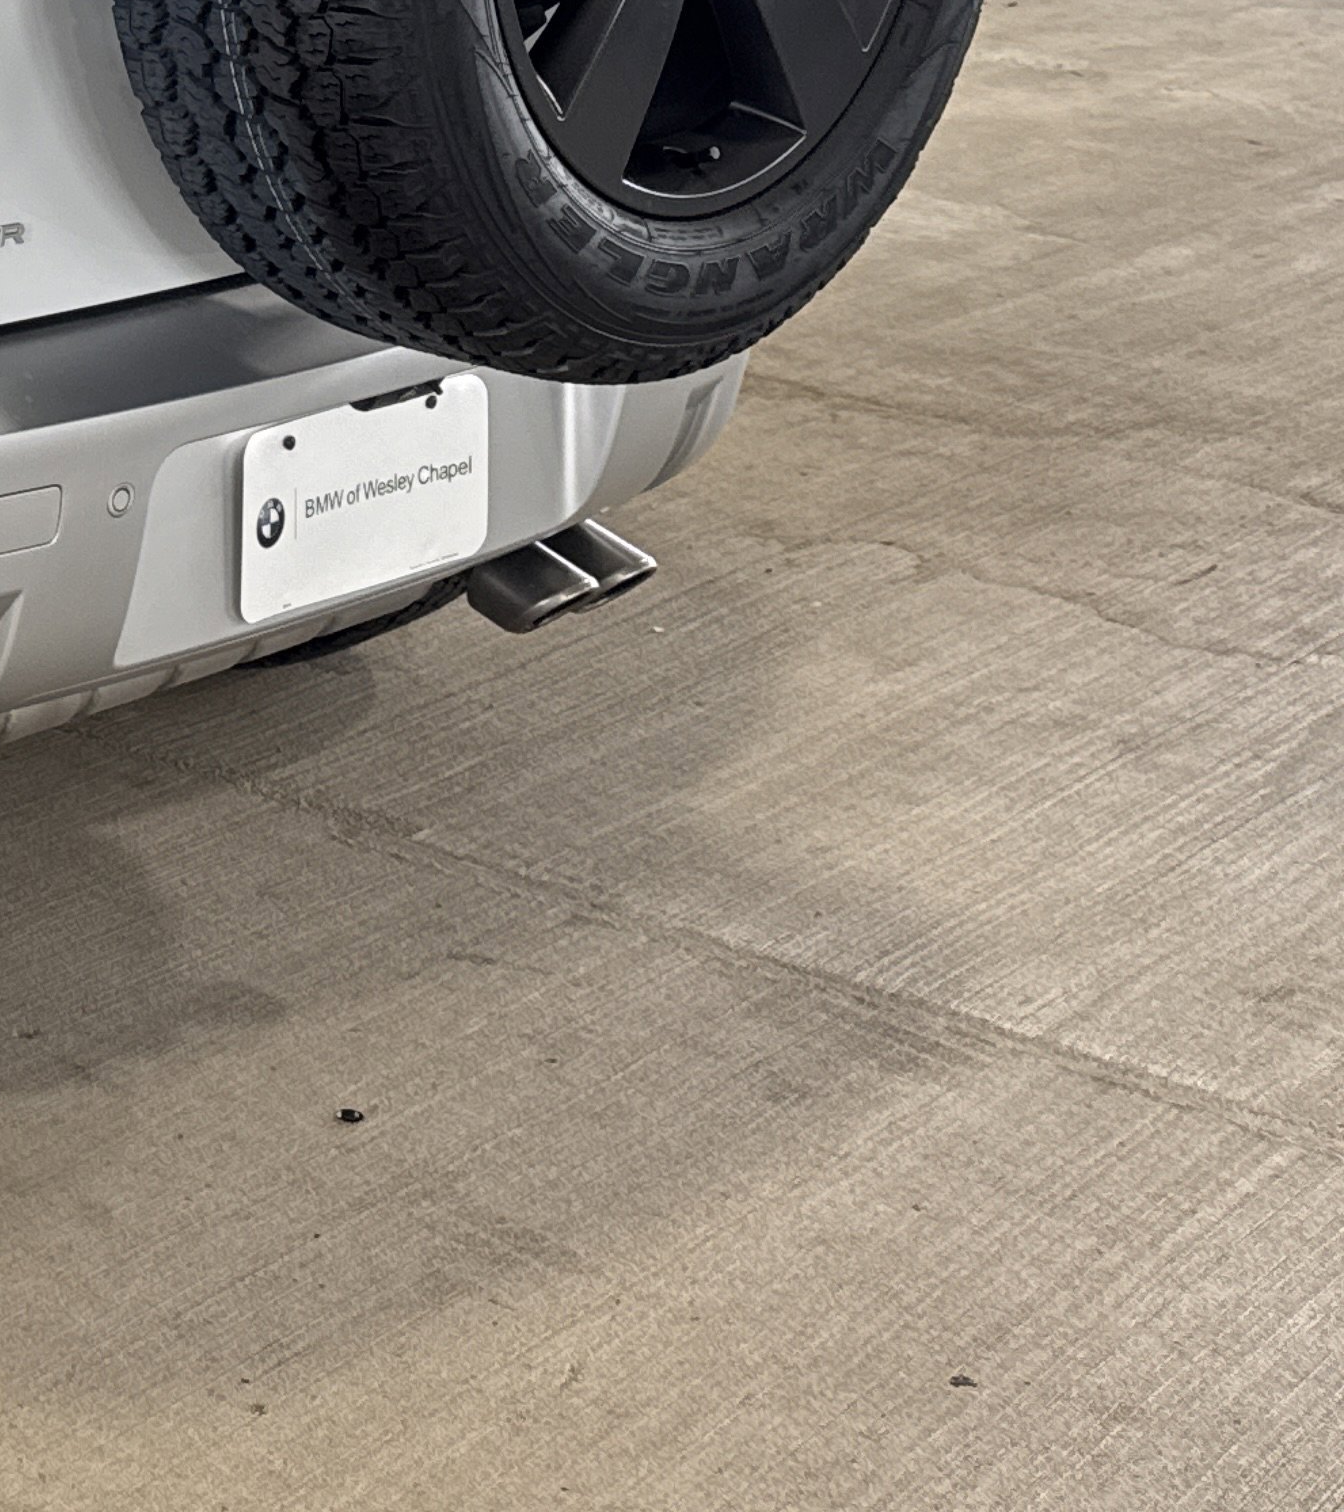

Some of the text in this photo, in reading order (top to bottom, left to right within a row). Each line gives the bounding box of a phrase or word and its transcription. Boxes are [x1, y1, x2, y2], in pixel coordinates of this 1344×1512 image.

[515, 138, 897, 299] WRANGLER
[305, 489, 345, 519] BMW
[346, 483, 361, 506] of
[362, 472, 416, 501] Wesley
[417, 455, 473, 486] Chapel
